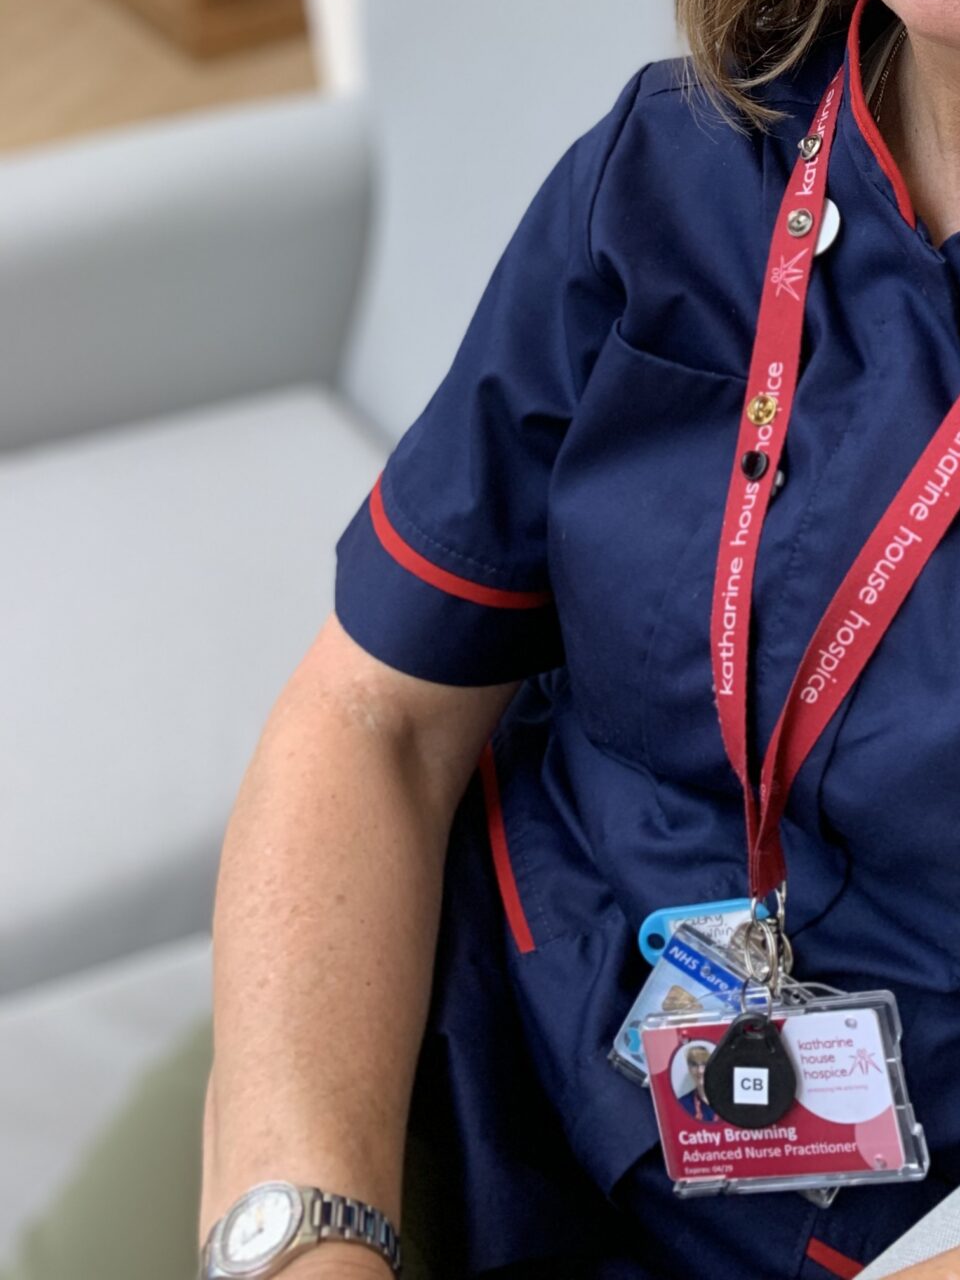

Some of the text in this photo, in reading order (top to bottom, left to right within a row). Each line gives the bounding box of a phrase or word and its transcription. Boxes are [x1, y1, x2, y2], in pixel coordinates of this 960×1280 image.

[795, 89, 835, 196] katrine
[729, 482, 760, 546] hous
[859, 525, 922, 605] house
[719, 556, 743, 696] katharine
[800, 610, 870, 704] hospice
[668, 946, 699, 970] NHS
[797, 1036, 854, 1051] katharine
[800, 1053, 835, 1065] house
[740, 1077, 764, 1091] CB
[803, 1066, 848, 1081] hospice
[678, 1124, 798, 1146] Cathy Browning
[683, 1141, 857, 1163] Advanced Nurse Practitioner
